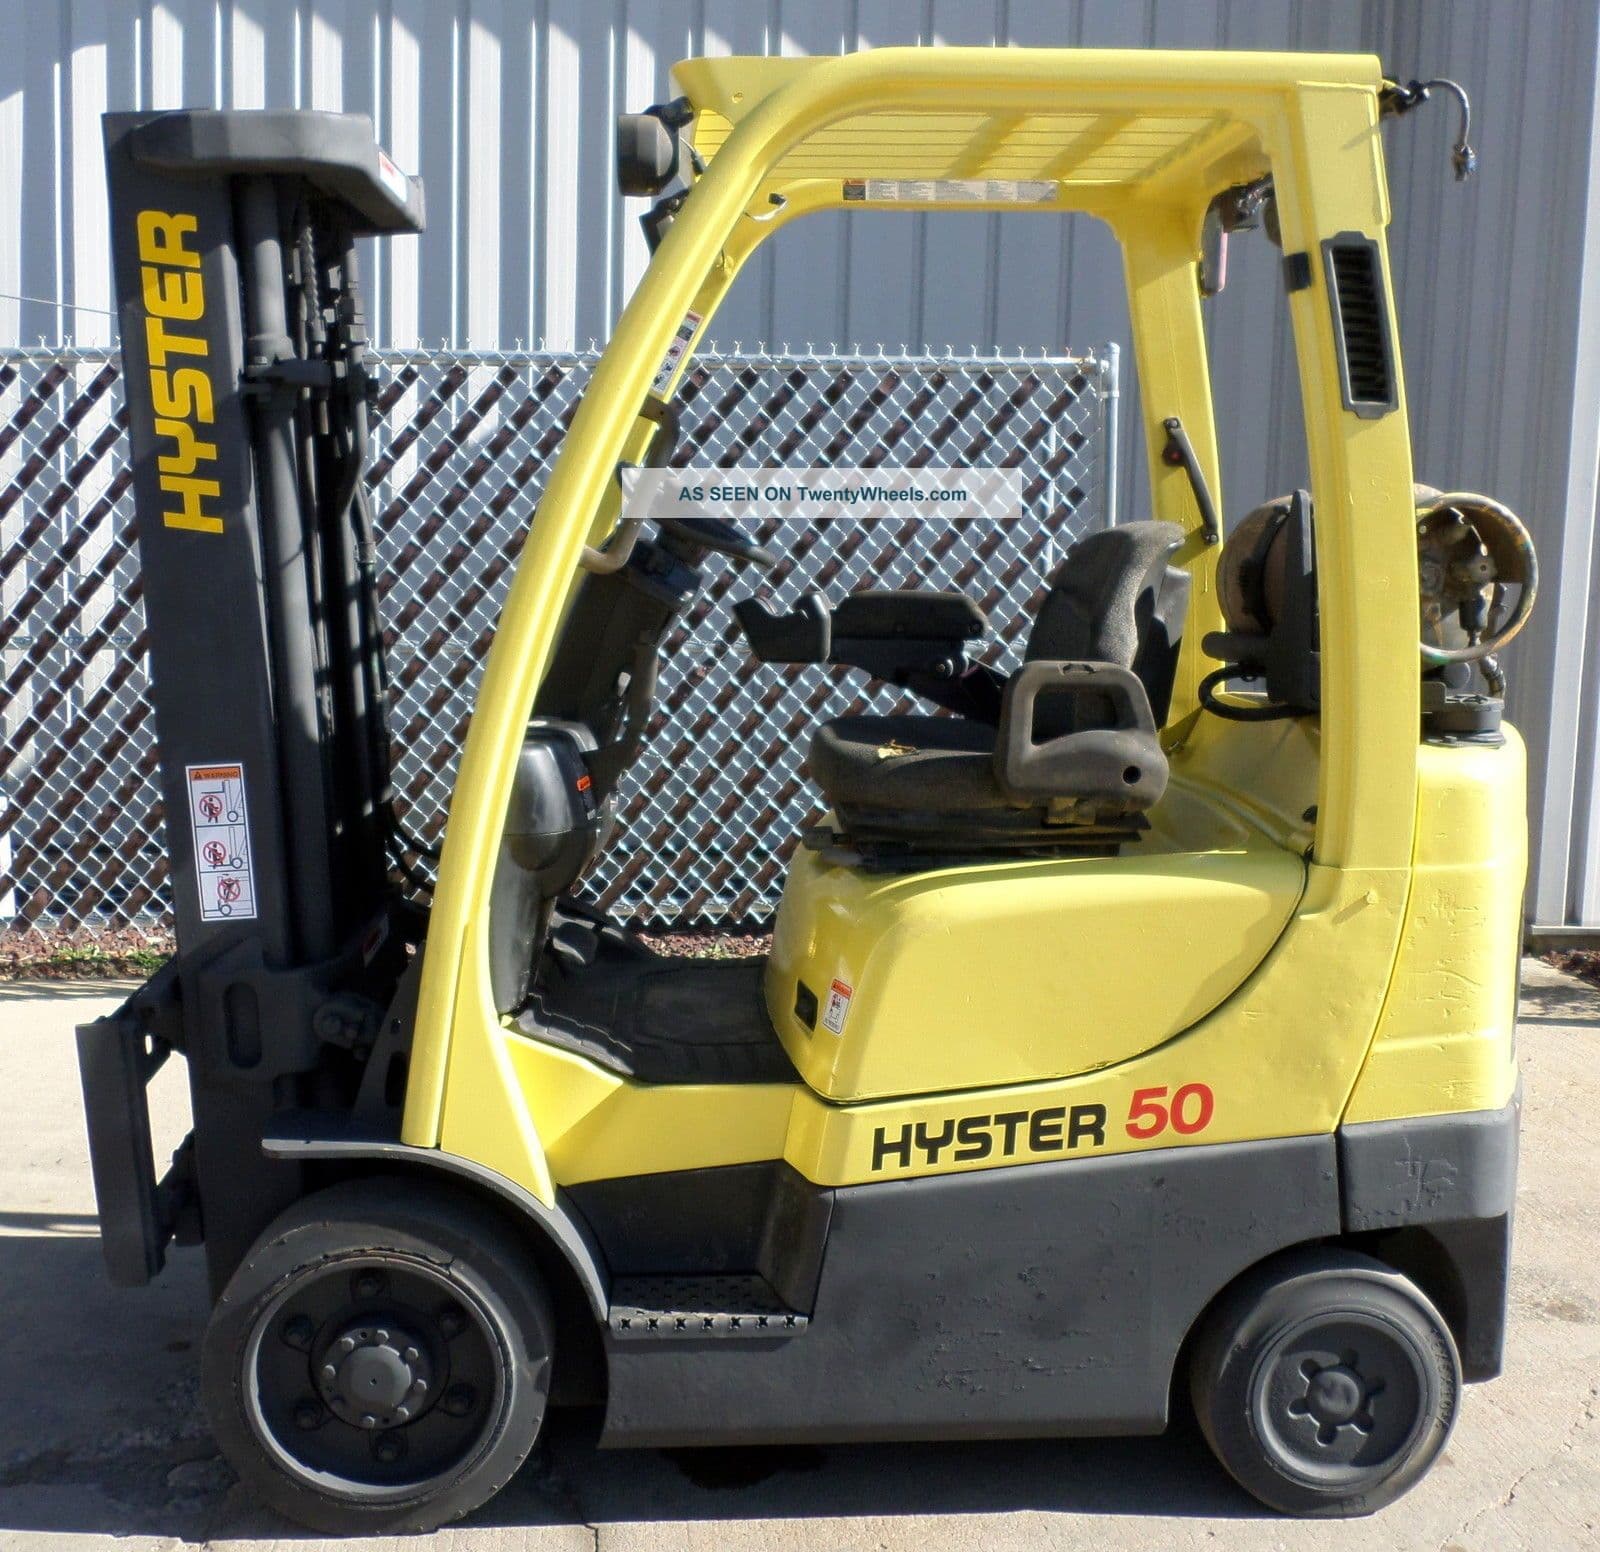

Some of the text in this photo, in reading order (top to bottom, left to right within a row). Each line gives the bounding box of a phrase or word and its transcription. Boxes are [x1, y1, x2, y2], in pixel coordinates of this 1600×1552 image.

[137, 210, 224, 534] HYSTER
[871, 1082, 1214, 1171] HYSTER 50
